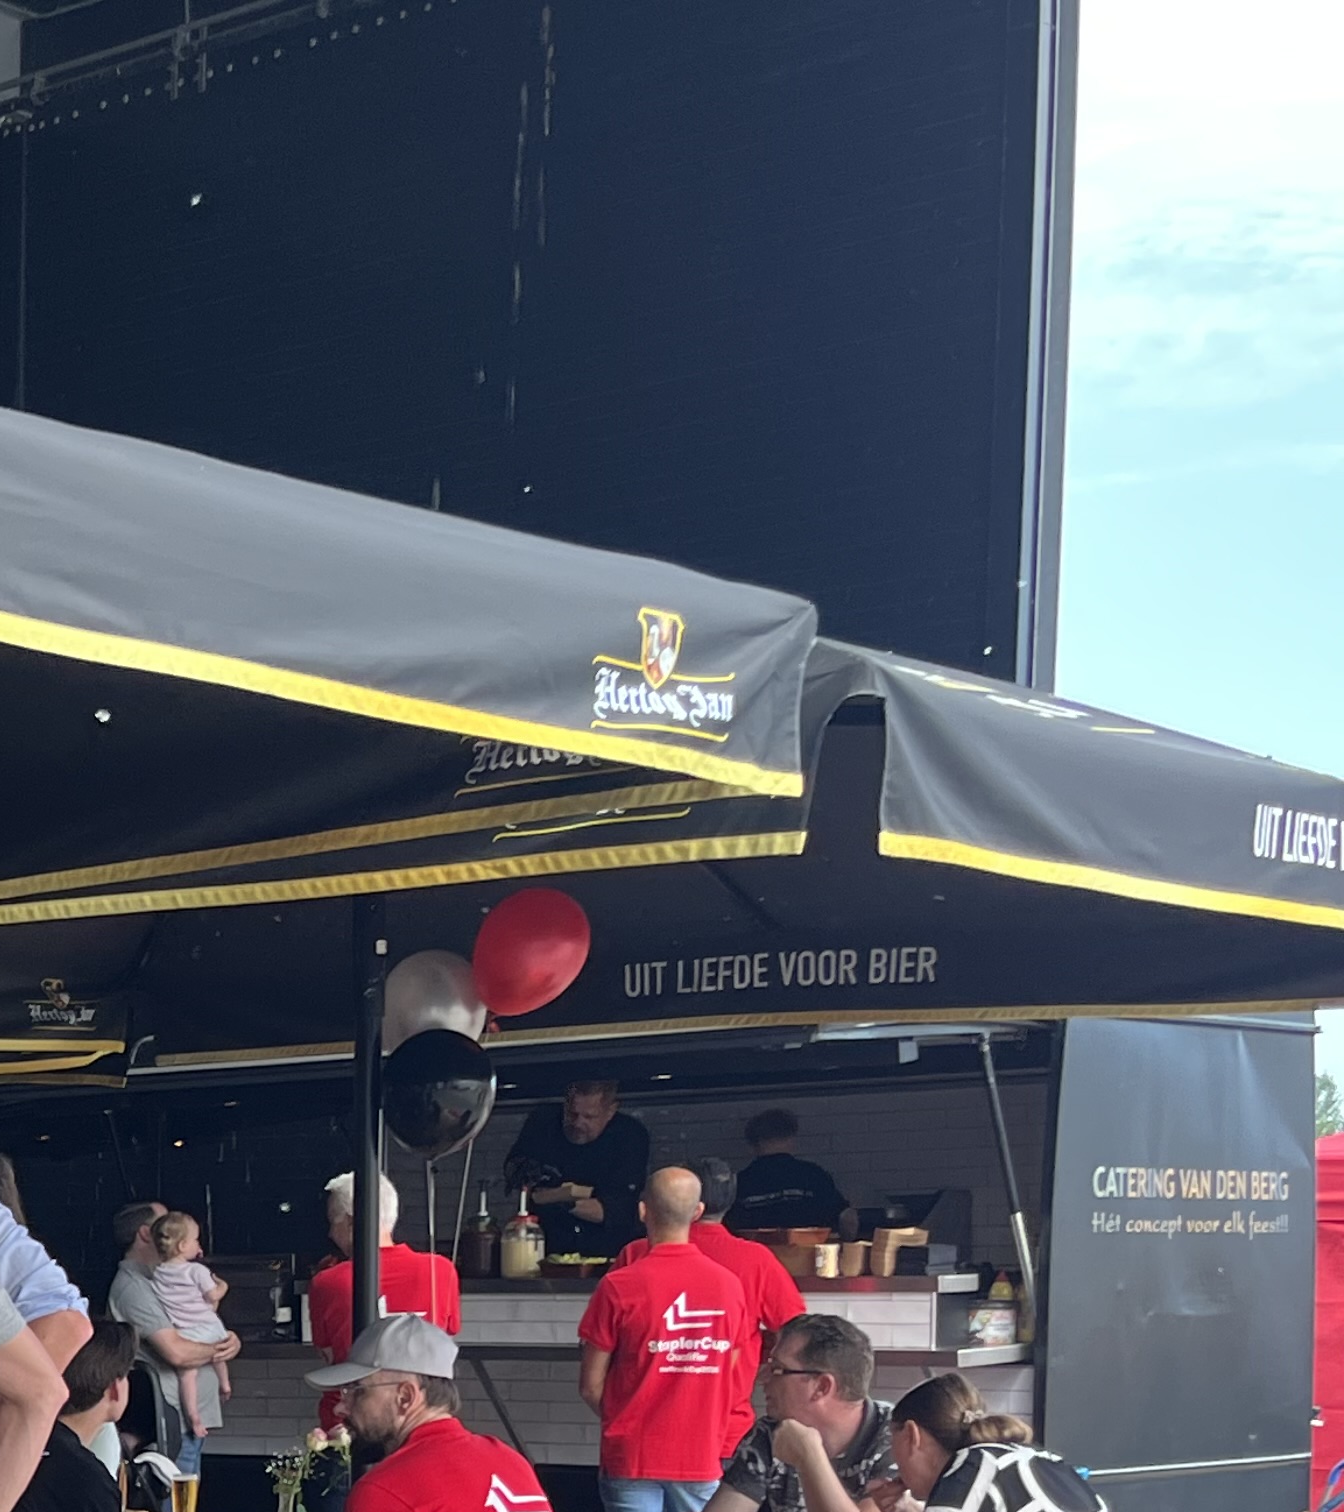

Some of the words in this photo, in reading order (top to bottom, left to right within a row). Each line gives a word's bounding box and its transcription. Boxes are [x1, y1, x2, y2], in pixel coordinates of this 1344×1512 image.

[1253, 803, 1283, 859] UIT
[1282, 810, 1338, 869] LIEFDE
[623, 961, 667, 997] UIT
[676, 953, 769, 993] LIEFDE
[778, 949, 857, 986] VOOR
[868, 946, 937, 984] BIER
[1092, 1166, 1176, 1199] CATERING
[1179, 1168, 1212, 1199] VAN
[1215, 1169, 1247, 1200] DEN
[1250, 1171, 1289, 1201] BERG
[1125, 1215, 1182, 1240] concept
[1186, 1218, 1221, 1233] voor
[1223, 1211, 1246, 1234] elk
[647, 1336, 731, 1354] StaplerCup
